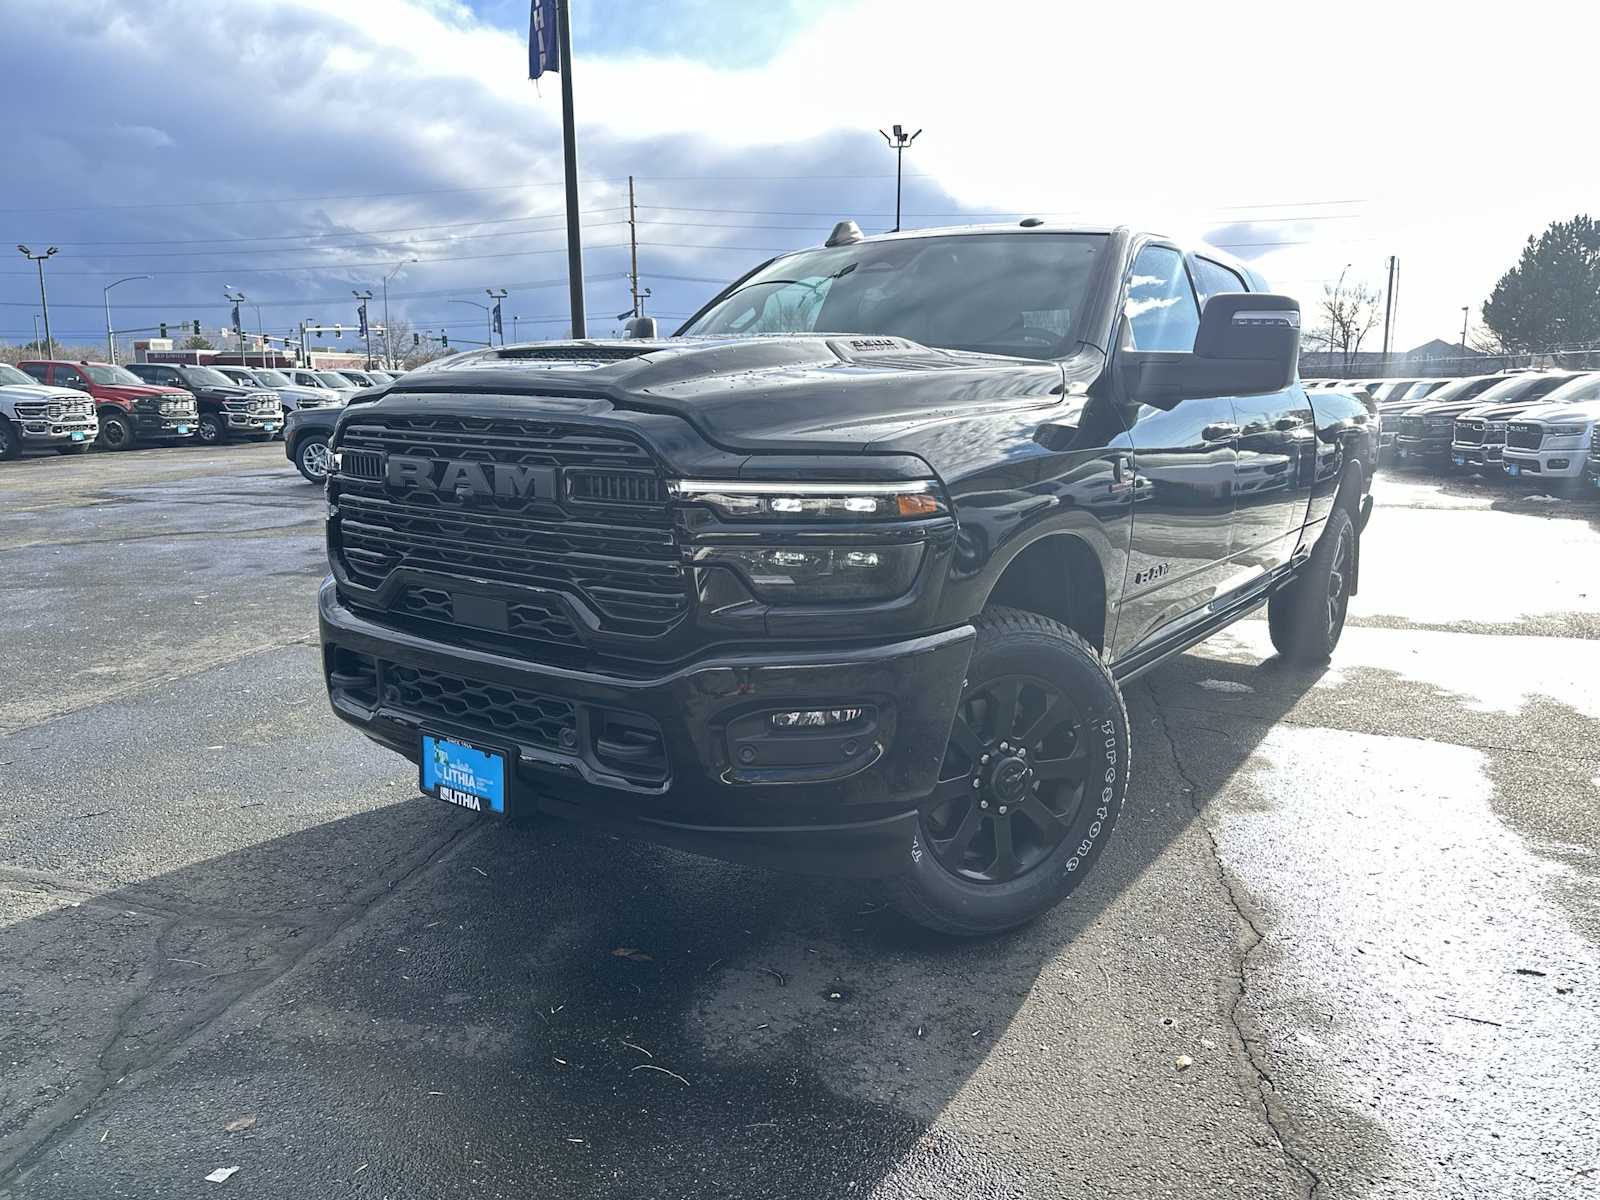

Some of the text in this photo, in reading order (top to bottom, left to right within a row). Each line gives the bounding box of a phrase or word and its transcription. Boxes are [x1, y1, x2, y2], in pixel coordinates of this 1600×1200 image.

[387, 454, 557, 499] RAM
[443, 766, 477, 789] LITHIA
[449, 788, 481, 811] LITHIA
